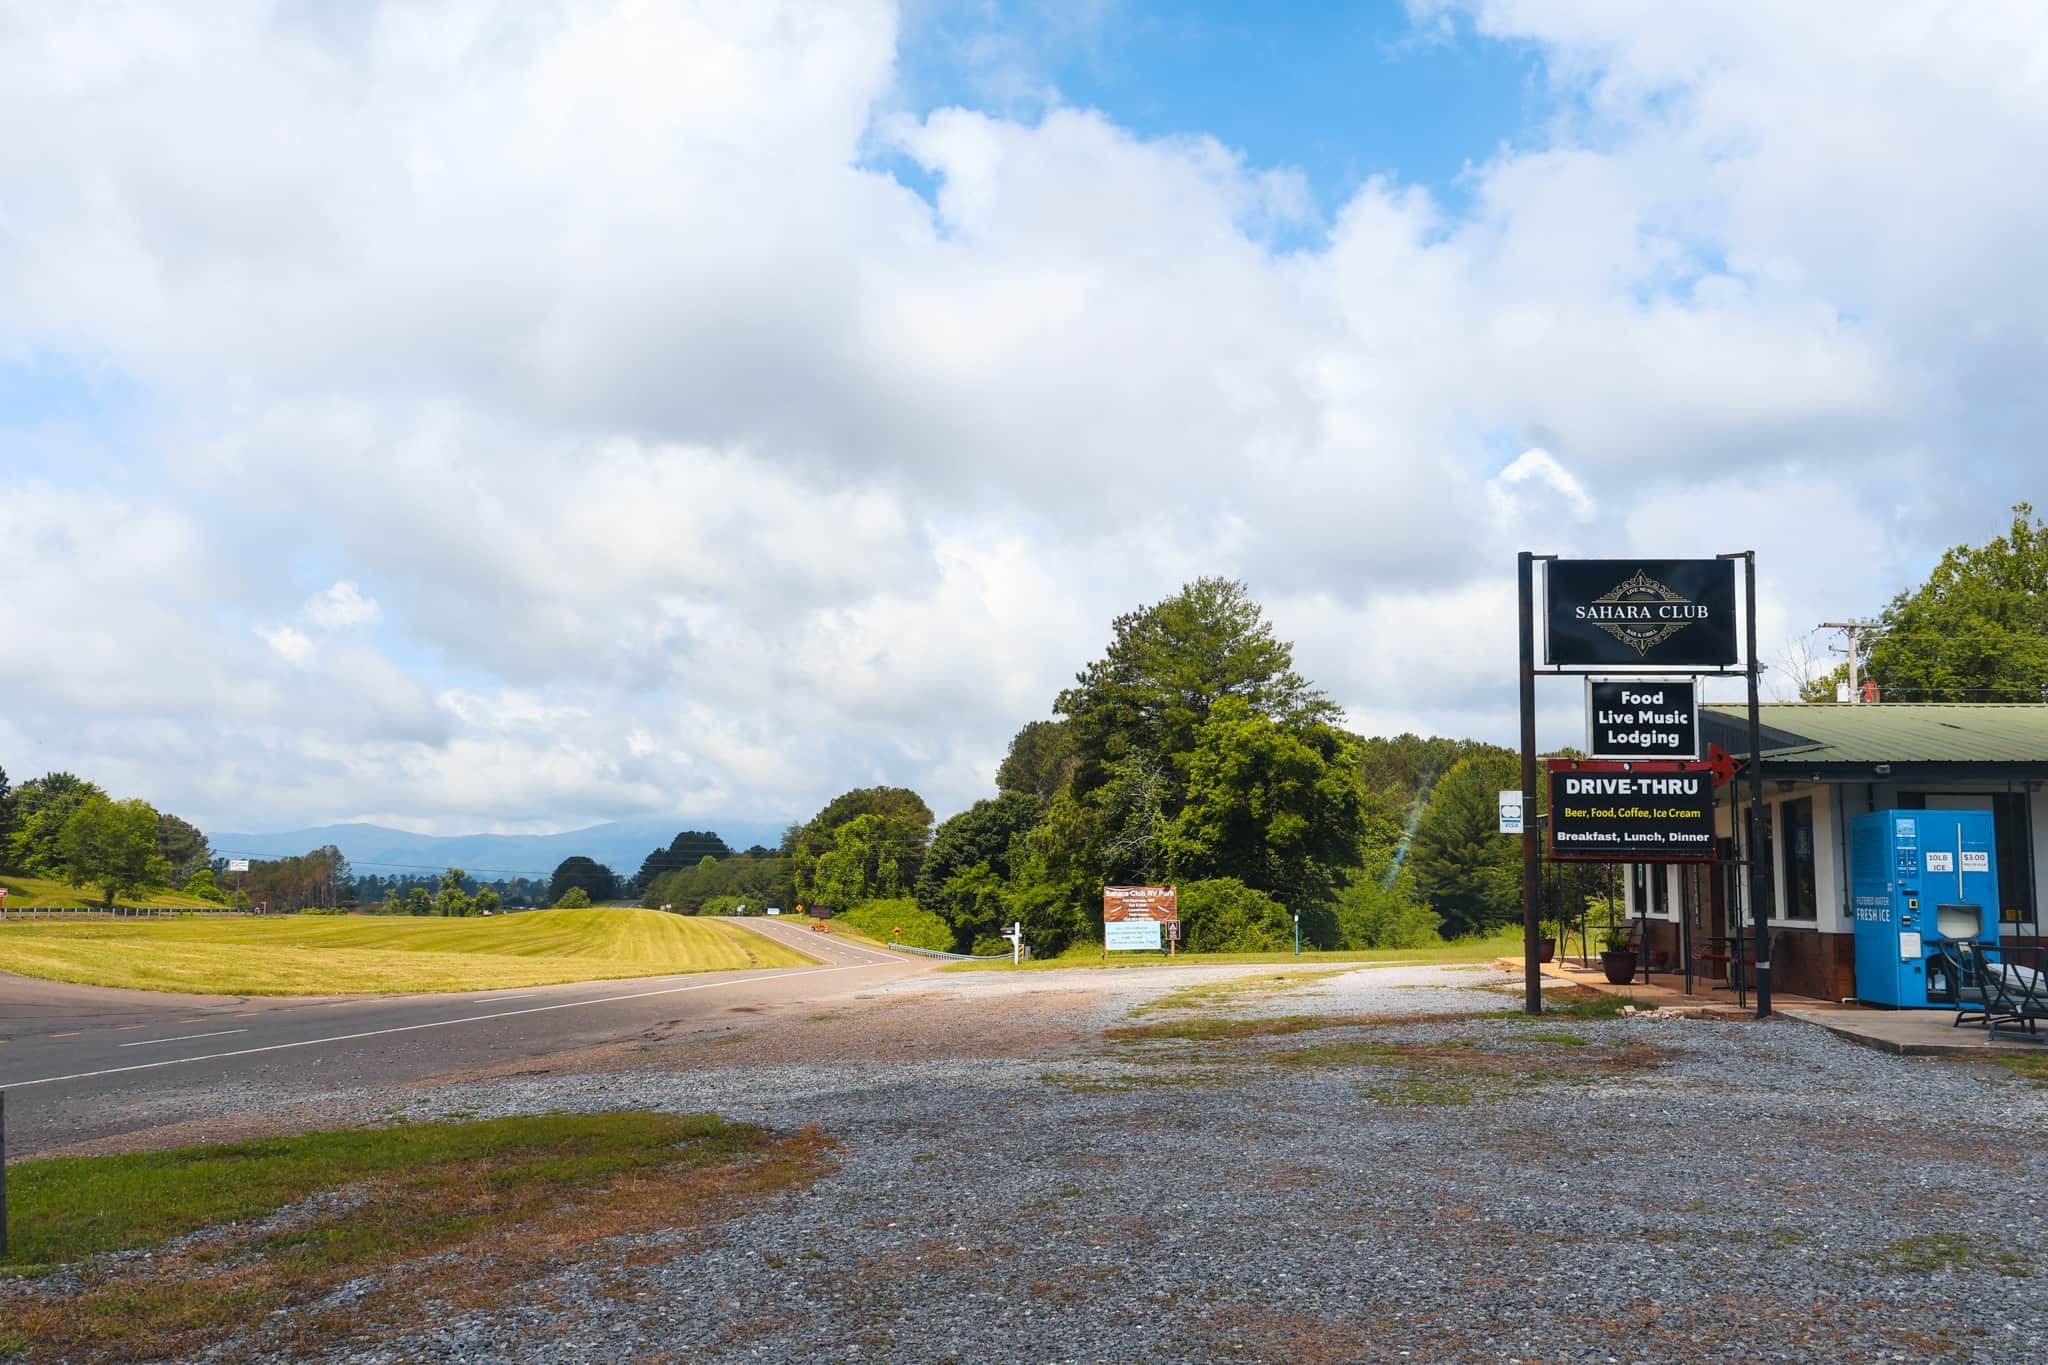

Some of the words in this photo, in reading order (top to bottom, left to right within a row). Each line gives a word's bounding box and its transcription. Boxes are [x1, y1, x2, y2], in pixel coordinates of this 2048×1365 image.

[1575, 605, 1652, 619] SAHARA
[1659, 605, 1709, 619] CLUB
[1621, 690, 1664, 705] Food
[1598, 710, 1634, 724] Live
[1638, 710, 1688, 724] Music
[1607, 729, 1680, 748] Lodging
[1565, 778, 1699, 795] DRIVE-THRU
[1564, 807, 1590, 818] Beer,
[1591, 807, 1617, 818] Food,
[1617, 807, 1652, 819] Coffee,
[1653, 808, 1667, 818] Ice
[1668, 808, 1701, 818] Cream
[1557, 831, 1621, 843] Breakfast,
[1624, 831, 1665, 843] Lunch,
[1669, 832, 1710, 842] Dinner
[1129, 889, 1146, 897] Club
[1147, 889, 1158, 897] RV
[1158, 889, 1175, 897] Park
[1856, 907, 1878, 921] FRESH
[1879, 909, 1891, 922] ICE
